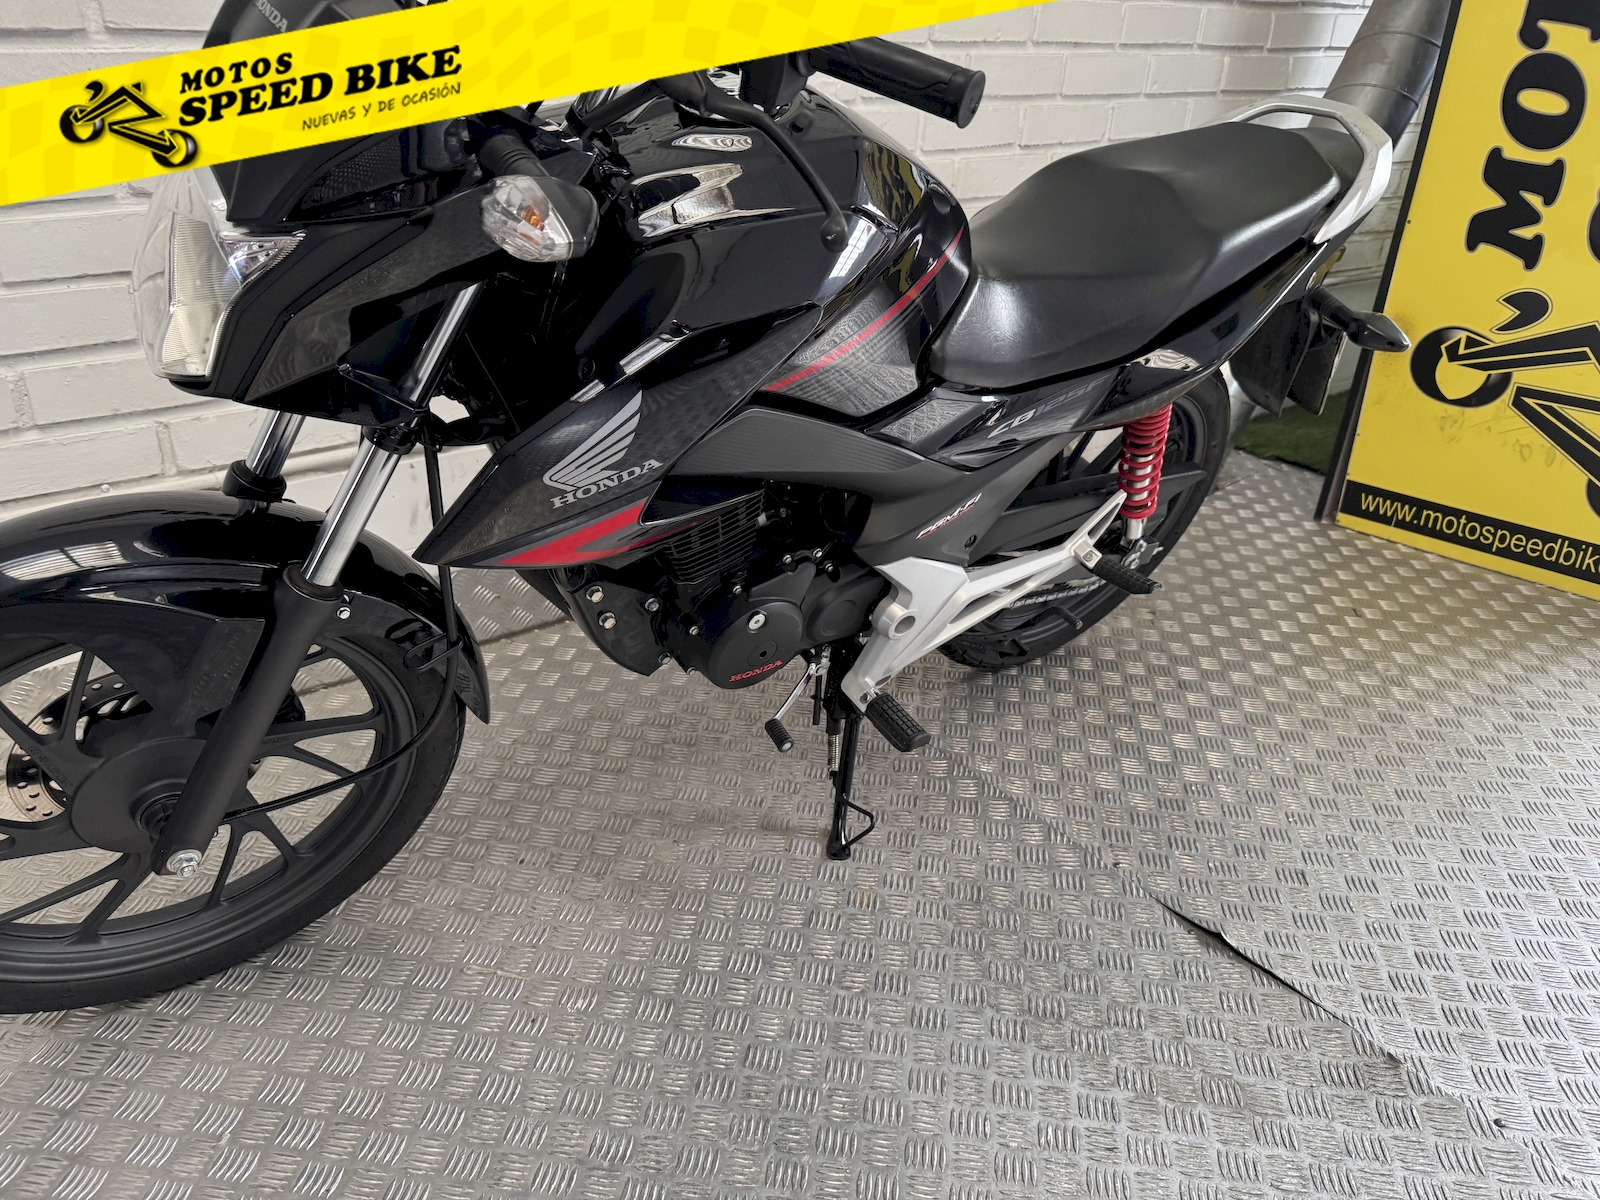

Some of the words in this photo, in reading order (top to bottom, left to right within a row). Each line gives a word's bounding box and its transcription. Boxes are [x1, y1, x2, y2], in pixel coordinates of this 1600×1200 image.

[255, 0, 288, 33] ONDA
[550, 459, 664, 509] HONDA
[1361, 492, 1600, 574] www.motospeedbik
[730, 660, 783, 682] HONDA
